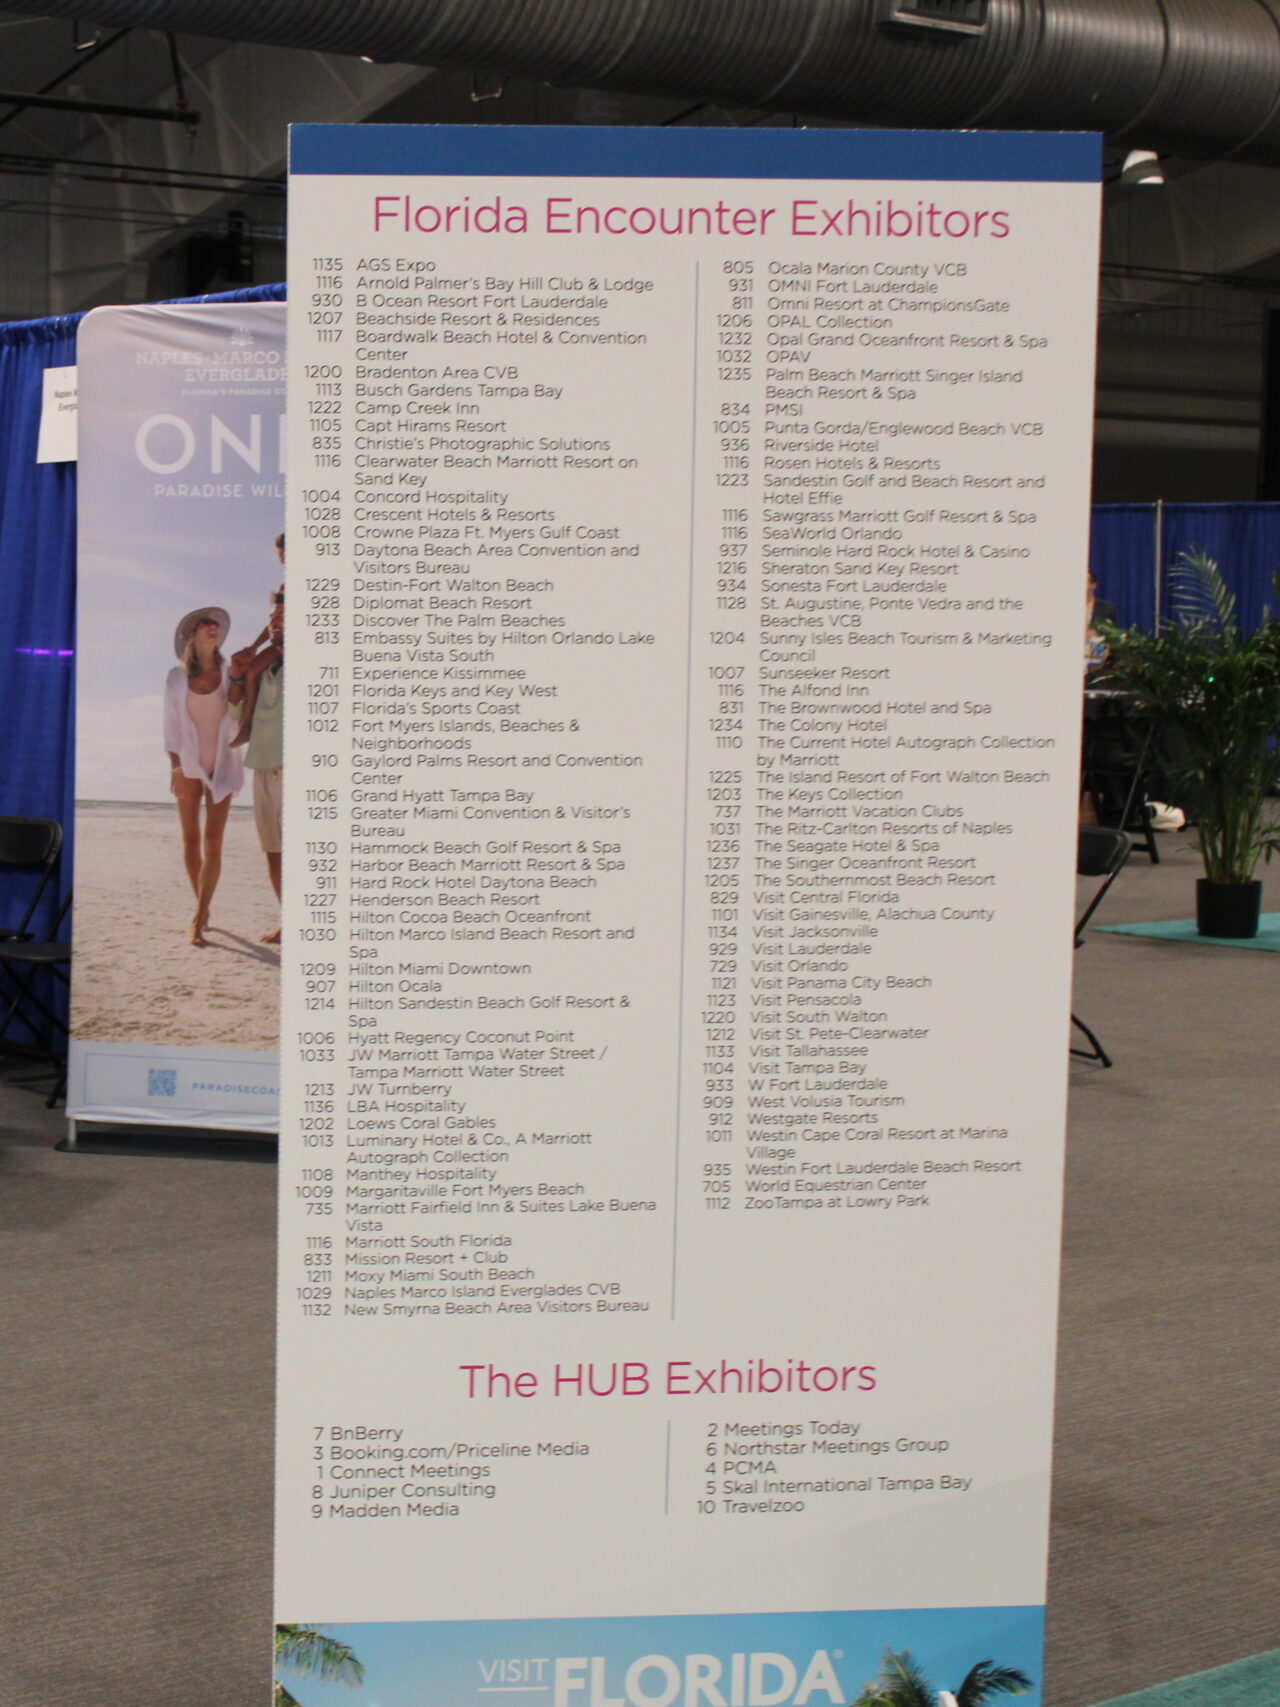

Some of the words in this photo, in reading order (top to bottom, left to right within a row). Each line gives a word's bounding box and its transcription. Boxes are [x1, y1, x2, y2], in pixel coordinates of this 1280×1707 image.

[375, 195, 528, 234] Florida
[547, 198, 777, 236] Encounter
[792, 200, 1010, 239] Exhibitors
[723, 261, 754, 275] 805
[769, 261, 813, 275] Ocala
[818, 262, 869, 276] Marion
[874, 262, 930, 279] County
[935, 263, 968, 277] VCB
[316, 276, 343, 290] 1116
[356, 276, 410, 290] Arnold
[486, 277, 515, 294] Bay
[520, 278, 543, 291] Hill
[548, 277, 584, 291] Club
[588, 278, 600, 291] &
[605, 278, 654, 294] Lodge
[136, 351, 202, 365] NAPLES
[214, 350, 280, 365] MARCO
[304, 365, 343, 379] 1200
[356, 366, 438, 379] Bradenton
[442, 366, 479, 380] Area
[484, 366, 519, 380] CVB
[721, 403, 751, 417] 834
[766, 403, 803, 417] PMSI
[714, 421, 751, 434] 1005
[765, 421, 810, 435] Punta
[814, 421, 954, 438] Gorda/Englewood
[959, 423, 1006, 436] Beach
[1011, 423, 1044, 436] VCB
[312, 437, 342, 450] 835
[430, 437, 535, 454] Photographic
[539, 437, 611, 451] Solutions
[721, 438, 751, 452] 936
[765, 439, 835, 453] Riverside
[839, 440, 879, 453] Hotel
[154, 484, 243, 498] PARADISE
[251, 484, 287, 498] WIL
[302, 490, 341, 504] 1004
[354, 490, 421, 504] Concord
[426, 491, 509, 507] Hospitality
[717, 579, 747, 593] 934
[762, 579, 822, 593] Sonesta
[827, 580, 858, 593] Fort
[863, 580, 948, 593] Lauderdale
[320, 667, 340, 680] 711
[353, 667, 440, 682] Experience
[443, 667, 527, 680] Kissimmee
[306, 789, 338, 803] 1106
[351, 789, 399, 803] Grand
[403, 790, 445, 805] Hyatt
[449, 789, 501, 804] Tampa
[505, 789, 535, 805] Bay
[707, 788, 742, 801] 1203
[756, 788, 784, 801] The
[789, 788, 824, 804] Keys
[828, 788, 903, 801] Collection
[711, 891, 740, 905] 829
[754, 892, 786, 905] Visit
[790, 891, 843, 904] Central
[848, 891, 900, 904] Florida
[306, 980, 337, 994] 907
[349, 980, 394, 993] Hilton
[399, 980, 443, 993] Ocala
[712, 977, 737, 990] 1121
[752, 977, 783, 990] Visit
[788, 977, 848, 990] Panama
[852, 976, 882, 991] City
[886, 976, 932, 989] Beach
[706, 1045, 735, 1058] 1133
[749, 1045, 781, 1058] Visit
[786, 1045, 869, 1057] Tallahassee
[299, 1118, 335, 1131] 1202
[348, 1118, 396, 1130] Loews
[400, 1117, 440, 1130] Coral
[445, 1117, 497, 1130] Gables
[709, 1113, 733, 1126] 912
[748, 1113, 818, 1128] Westgate
[823, 1112, 879, 1125] Resorts
[302, 1169, 334, 1182] 1108
[347, 1168, 412, 1183] Manthey
[416, 1167, 497, 1182] Hospitality
[703, 1181, 732, 1193] 705
[746, 1180, 791, 1193] World
[795, 1179, 874, 1194] Equestrian
[878, 1178, 928, 1191] Center
[706, 1197, 731, 1210] 1112
[745, 1197, 824, 1210] ZooTampa
[828, 1197, 843, 1209] at
[847, 1196, 893, 1210] Lowry
[897, 1195, 930, 1207] Park
[302, 1304, 332, 1317] 1132
[345, 1304, 379, 1316] New
[384, 1303, 441, 1318] Smyrna
[445, 1302, 492, 1315] Beach
[496, 1302, 532, 1314] Area
[537, 1301, 593, 1313] Visitors
[597, 1300, 649, 1313] Bureau
[459, 1364, 539, 1399] The
[555, 1362, 650, 1397] HUB
[667, 1359, 877, 1395] Exhibitors
[314, 1427, 325, 1441] 7
[331, 1426, 404, 1443] BnBerry
[708, 1423, 719, 1438] 2
[725, 1422, 804, 1439] Meetings
[809, 1421, 861, 1437] Today
[313, 1446, 324, 1461] 3
[331, 1443, 532, 1462] Booking.com/Priceline
[537, 1442, 590, 1457] Media
[707, 1442, 718, 1457] 6
[725, 1441, 807, 1456] Northstar
[813, 1440, 891, 1456] Meetings
[896, 1438, 950, 1454] Group
[318, 1466, 324, 1480] 1
[330, 1465, 406, 1480] Connect
[411, 1463, 491, 1480] Meetings
[705, 1462, 717, 1475] 4
[724, 1461, 778, 1475] PCMA
[312, 1485, 324, 1500] 8
[330, 1484, 397, 1501] Juniper
[402, 1482, 497, 1499] Consulting
[706, 1481, 717, 1496] 5
[764, 1477, 872, 1494] International
[878, 1477, 935, 1492] Tampa
[940, 1475, 973, 1492] Bay
[312, 1504, 324, 1519] 9
[330, 1504, 401, 1519] Madden
[407, 1502, 460, 1517] Media
[698, 1500, 716, 1515] 10
[722, 1499, 805, 1514] Travelzoo
[478, 1658, 550, 1683] VISIT
[554, 1649, 846, 1707] FLORIDA
